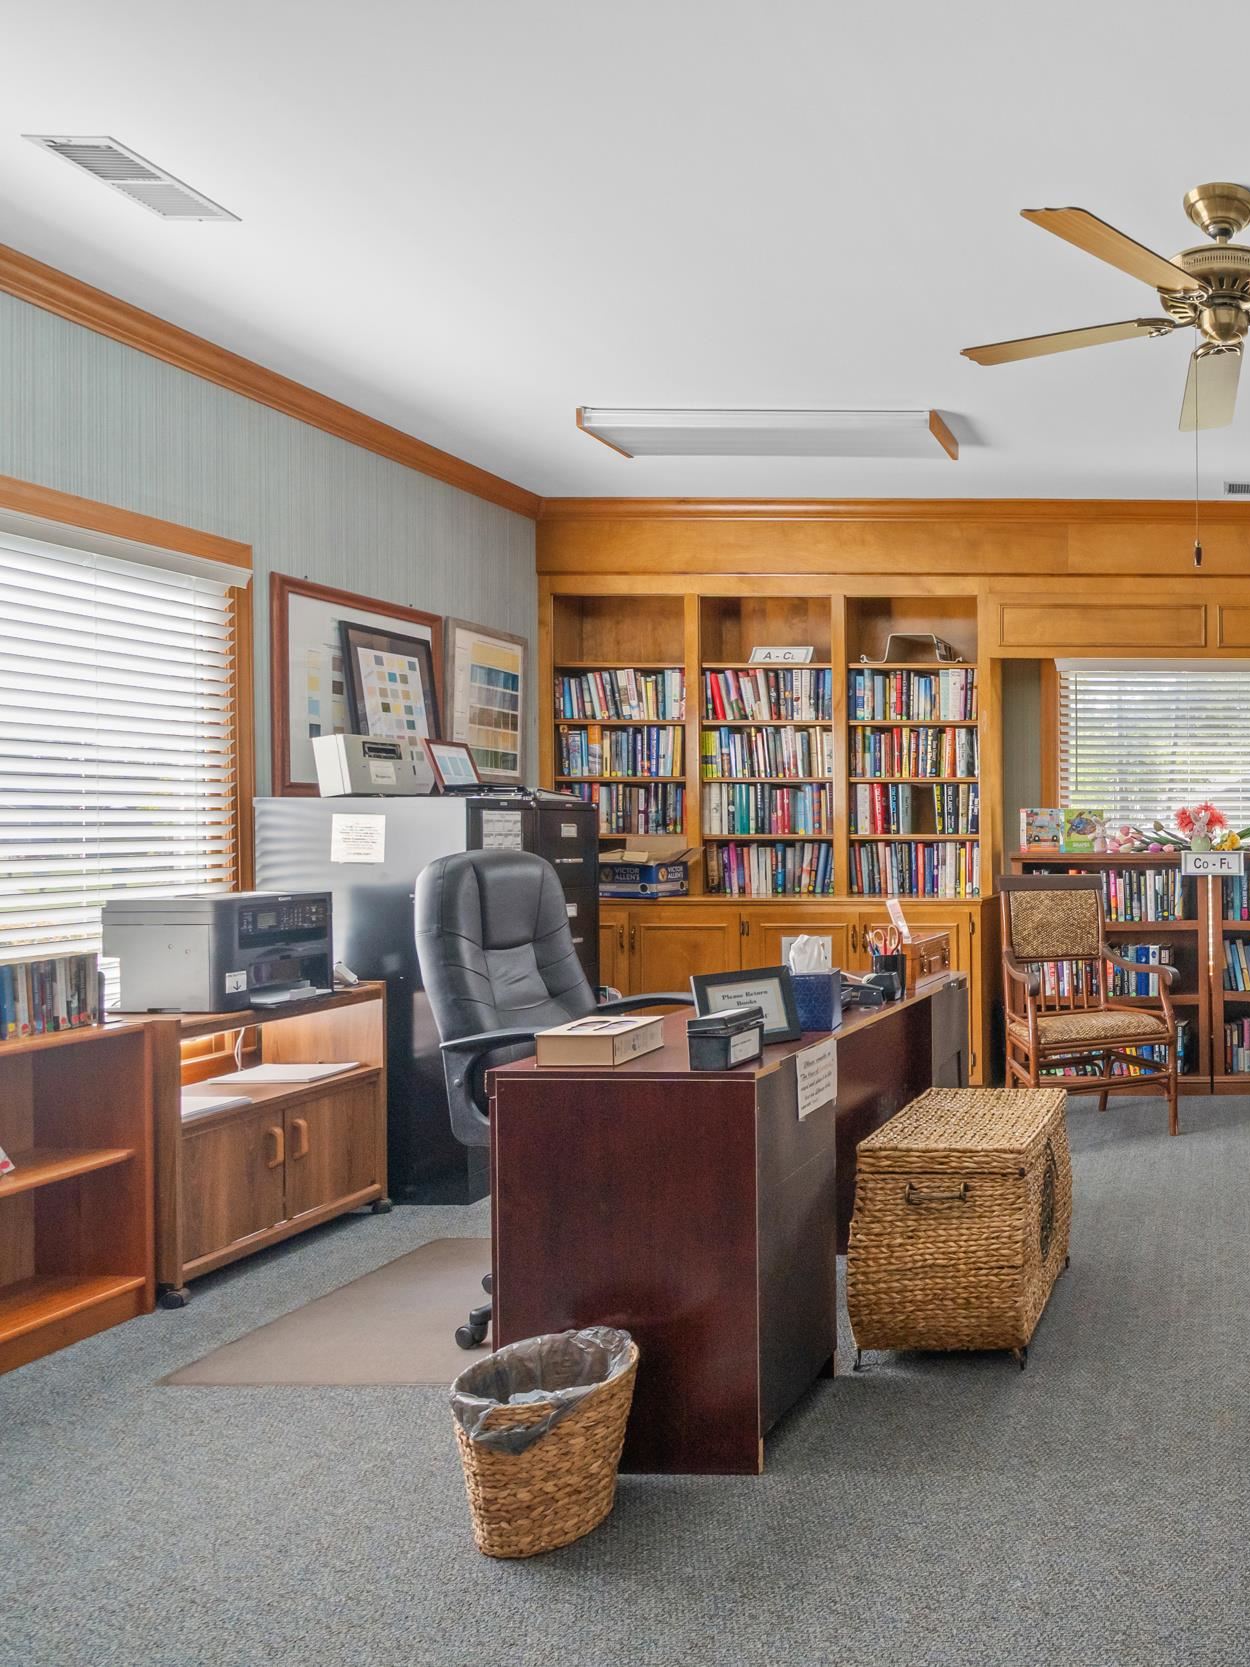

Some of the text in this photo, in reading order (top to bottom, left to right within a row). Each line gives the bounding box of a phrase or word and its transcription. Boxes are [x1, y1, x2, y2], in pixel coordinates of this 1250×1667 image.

[763, 651, 772, 660] A
[721, 990, 768, 1001] Please Return
